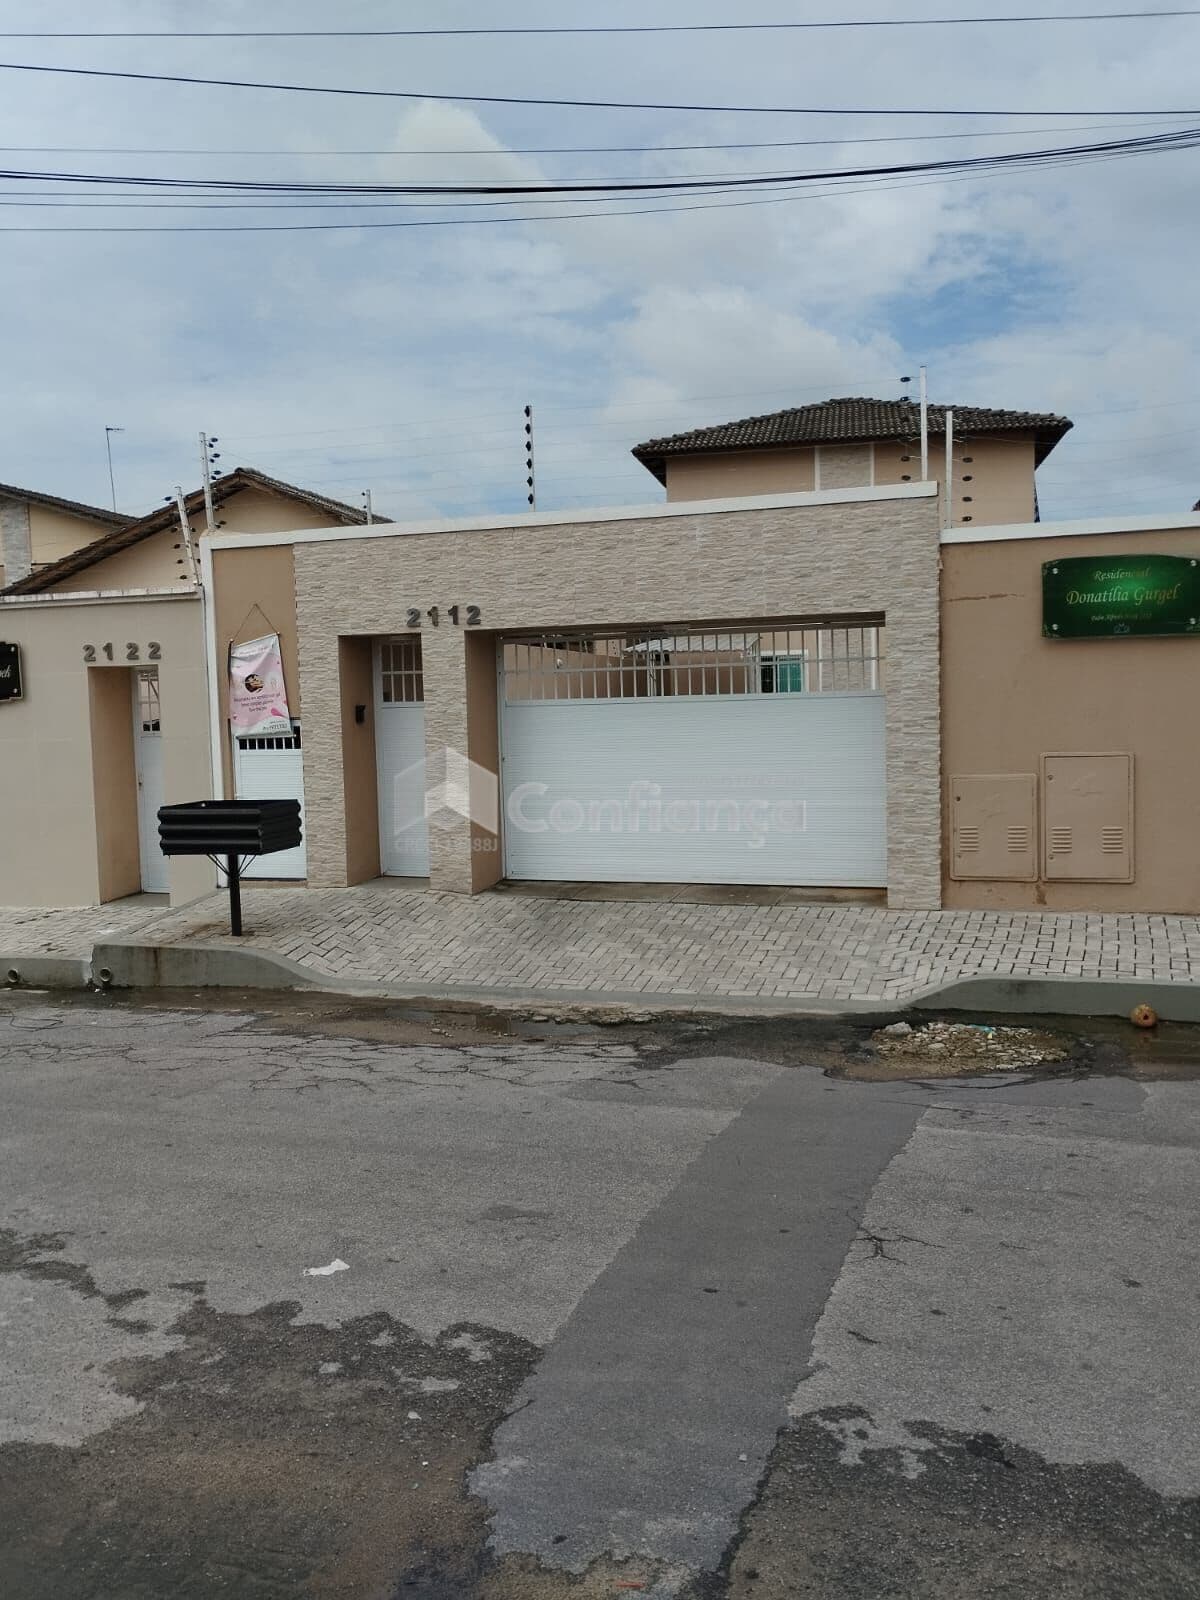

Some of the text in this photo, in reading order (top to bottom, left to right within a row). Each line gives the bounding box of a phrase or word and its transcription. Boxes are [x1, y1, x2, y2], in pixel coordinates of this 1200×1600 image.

[1094, 568, 1151, 581] Residenal
[1134, 583, 1181, 606] Gurgel
[406, 605, 482, 627] 2112
[82, 641, 162, 662] 2122
